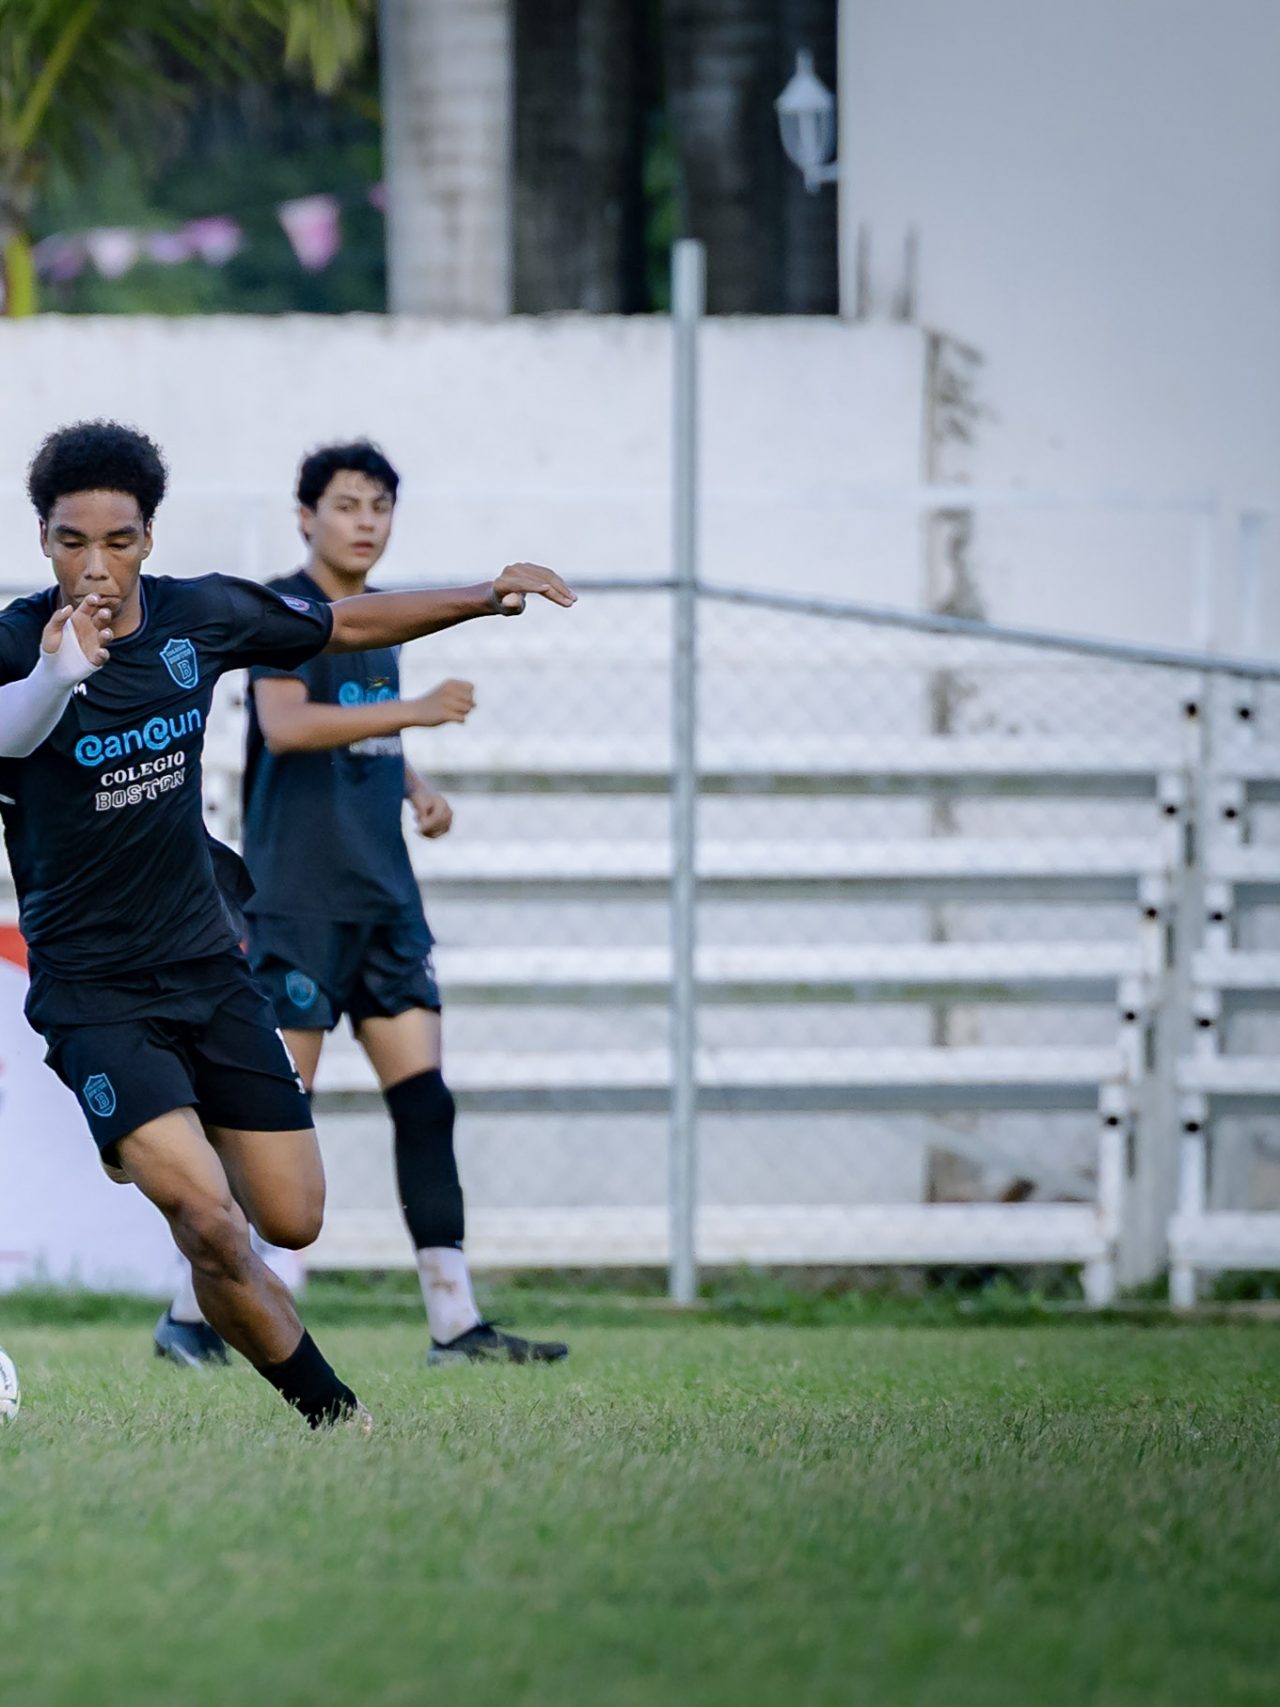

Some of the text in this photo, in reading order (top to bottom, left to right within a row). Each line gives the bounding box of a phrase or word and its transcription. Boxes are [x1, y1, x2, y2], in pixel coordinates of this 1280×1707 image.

[177, 659, 192, 680] B
[100, 751, 185, 787] COLEGIO
[95, 767, 186, 811] BOSTON
